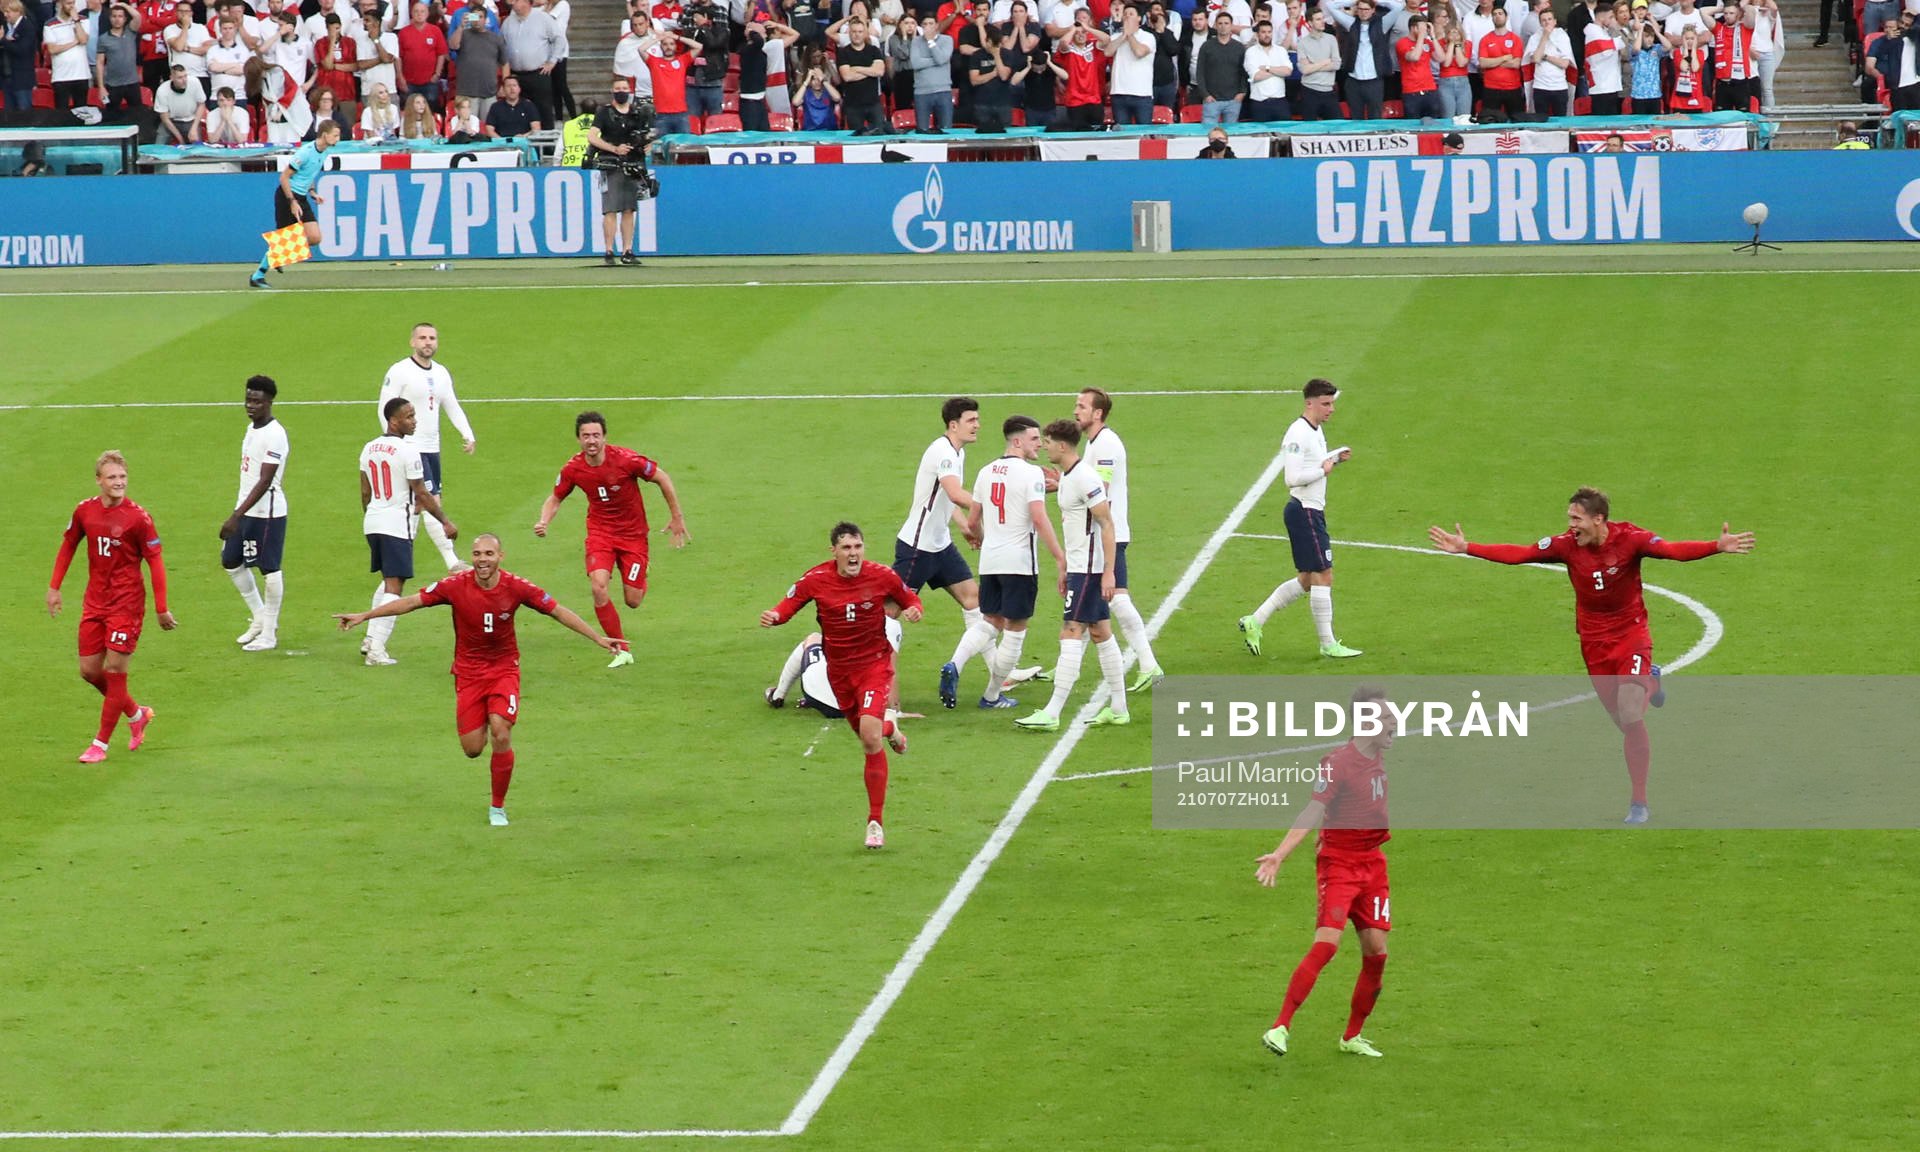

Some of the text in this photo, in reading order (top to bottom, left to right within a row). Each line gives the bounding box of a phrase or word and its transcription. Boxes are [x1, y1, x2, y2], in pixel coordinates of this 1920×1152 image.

[1300, 135, 1409, 155] SHAMELESS
[1315, 156, 1661, 245] GAZPROM
[953, 220, 1074, 251] GAZPROM
[368, 459, 393, 501] 10
[992, 465, 1009, 476] RICE
[990, 482, 1006, 525] 4
[97, 536, 111, 557] 12
[243, 540, 258, 557] 25
[628, 562, 641, 582] 8
[1592, 571, 1605, 590] 3
[1065, 590, 1074, 607] 5
[846, 603, 856, 622] 6
[484, 613, 494, 633] 9
[1631, 654, 1642, 675] 3
[507, 694, 517, 715] 9
[863, 691, 875, 708] 6
[1371, 775, 1386, 801] 14
[1373, 896, 1391, 923] 14
